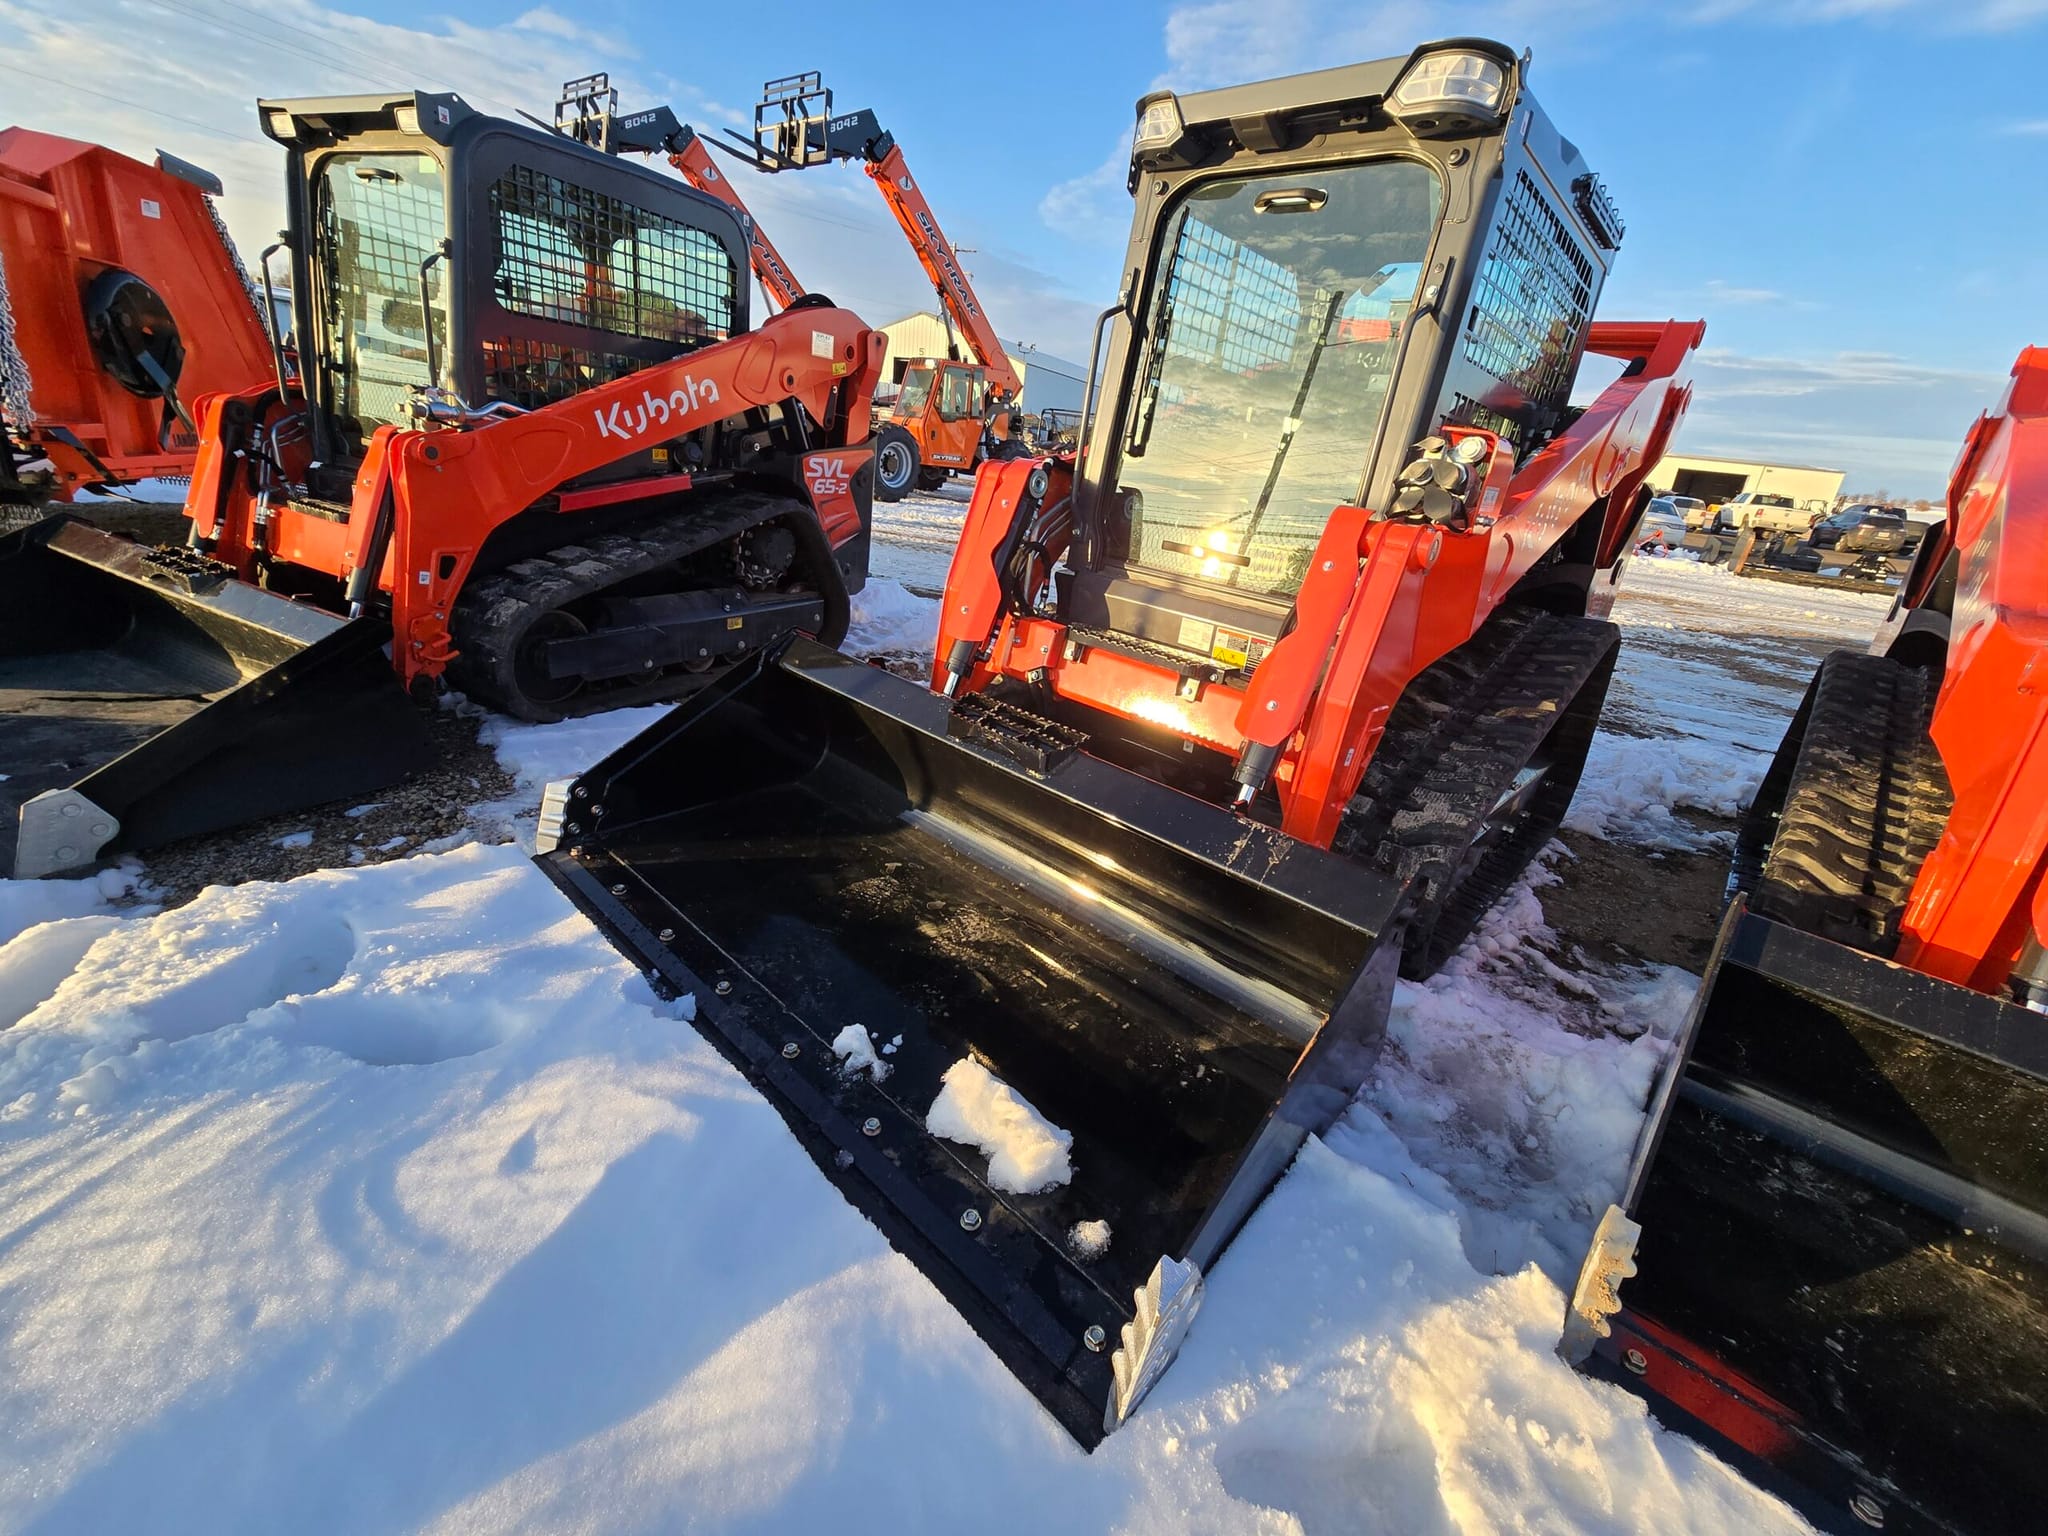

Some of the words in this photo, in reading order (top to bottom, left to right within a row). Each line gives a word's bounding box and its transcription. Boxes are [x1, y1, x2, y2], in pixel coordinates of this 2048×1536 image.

[624, 113, 657, 129] 8042
[916, 211, 979, 319] SKYTRAK
[594, 374, 720, 440] Kubota
[806, 457, 850, 479] SVL
[813, 479, 848, 495] 65-2
